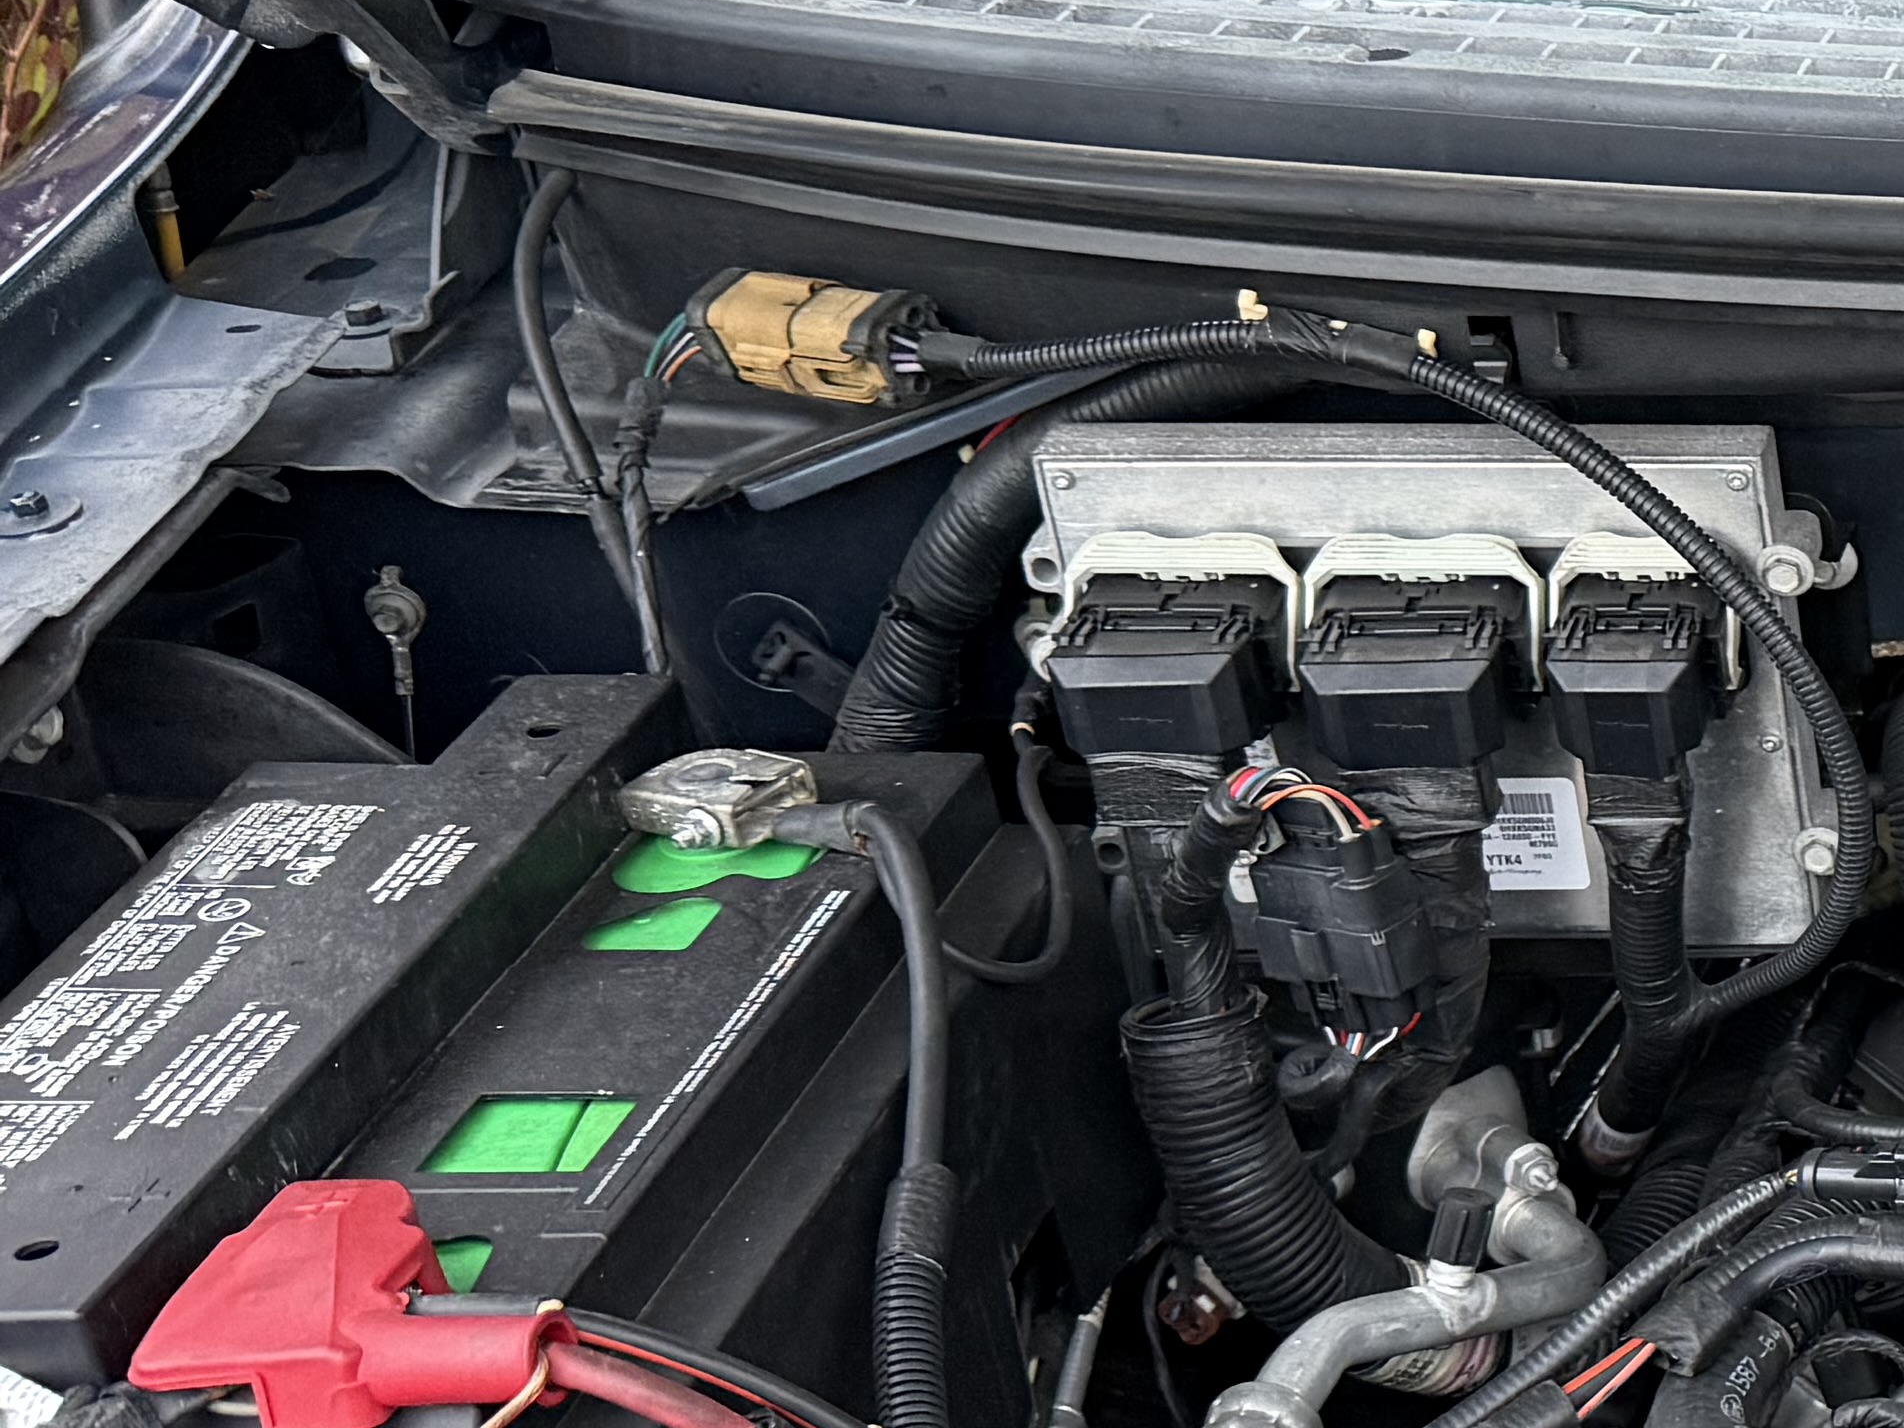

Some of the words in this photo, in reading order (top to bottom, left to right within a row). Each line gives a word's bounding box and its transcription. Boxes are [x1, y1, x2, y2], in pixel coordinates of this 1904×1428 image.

[1486, 854, 1522, 866] YTK4
[102, 945, 241, 1066] DANGER/POISON
[1725, 1356, 1759, 1396] 1587
